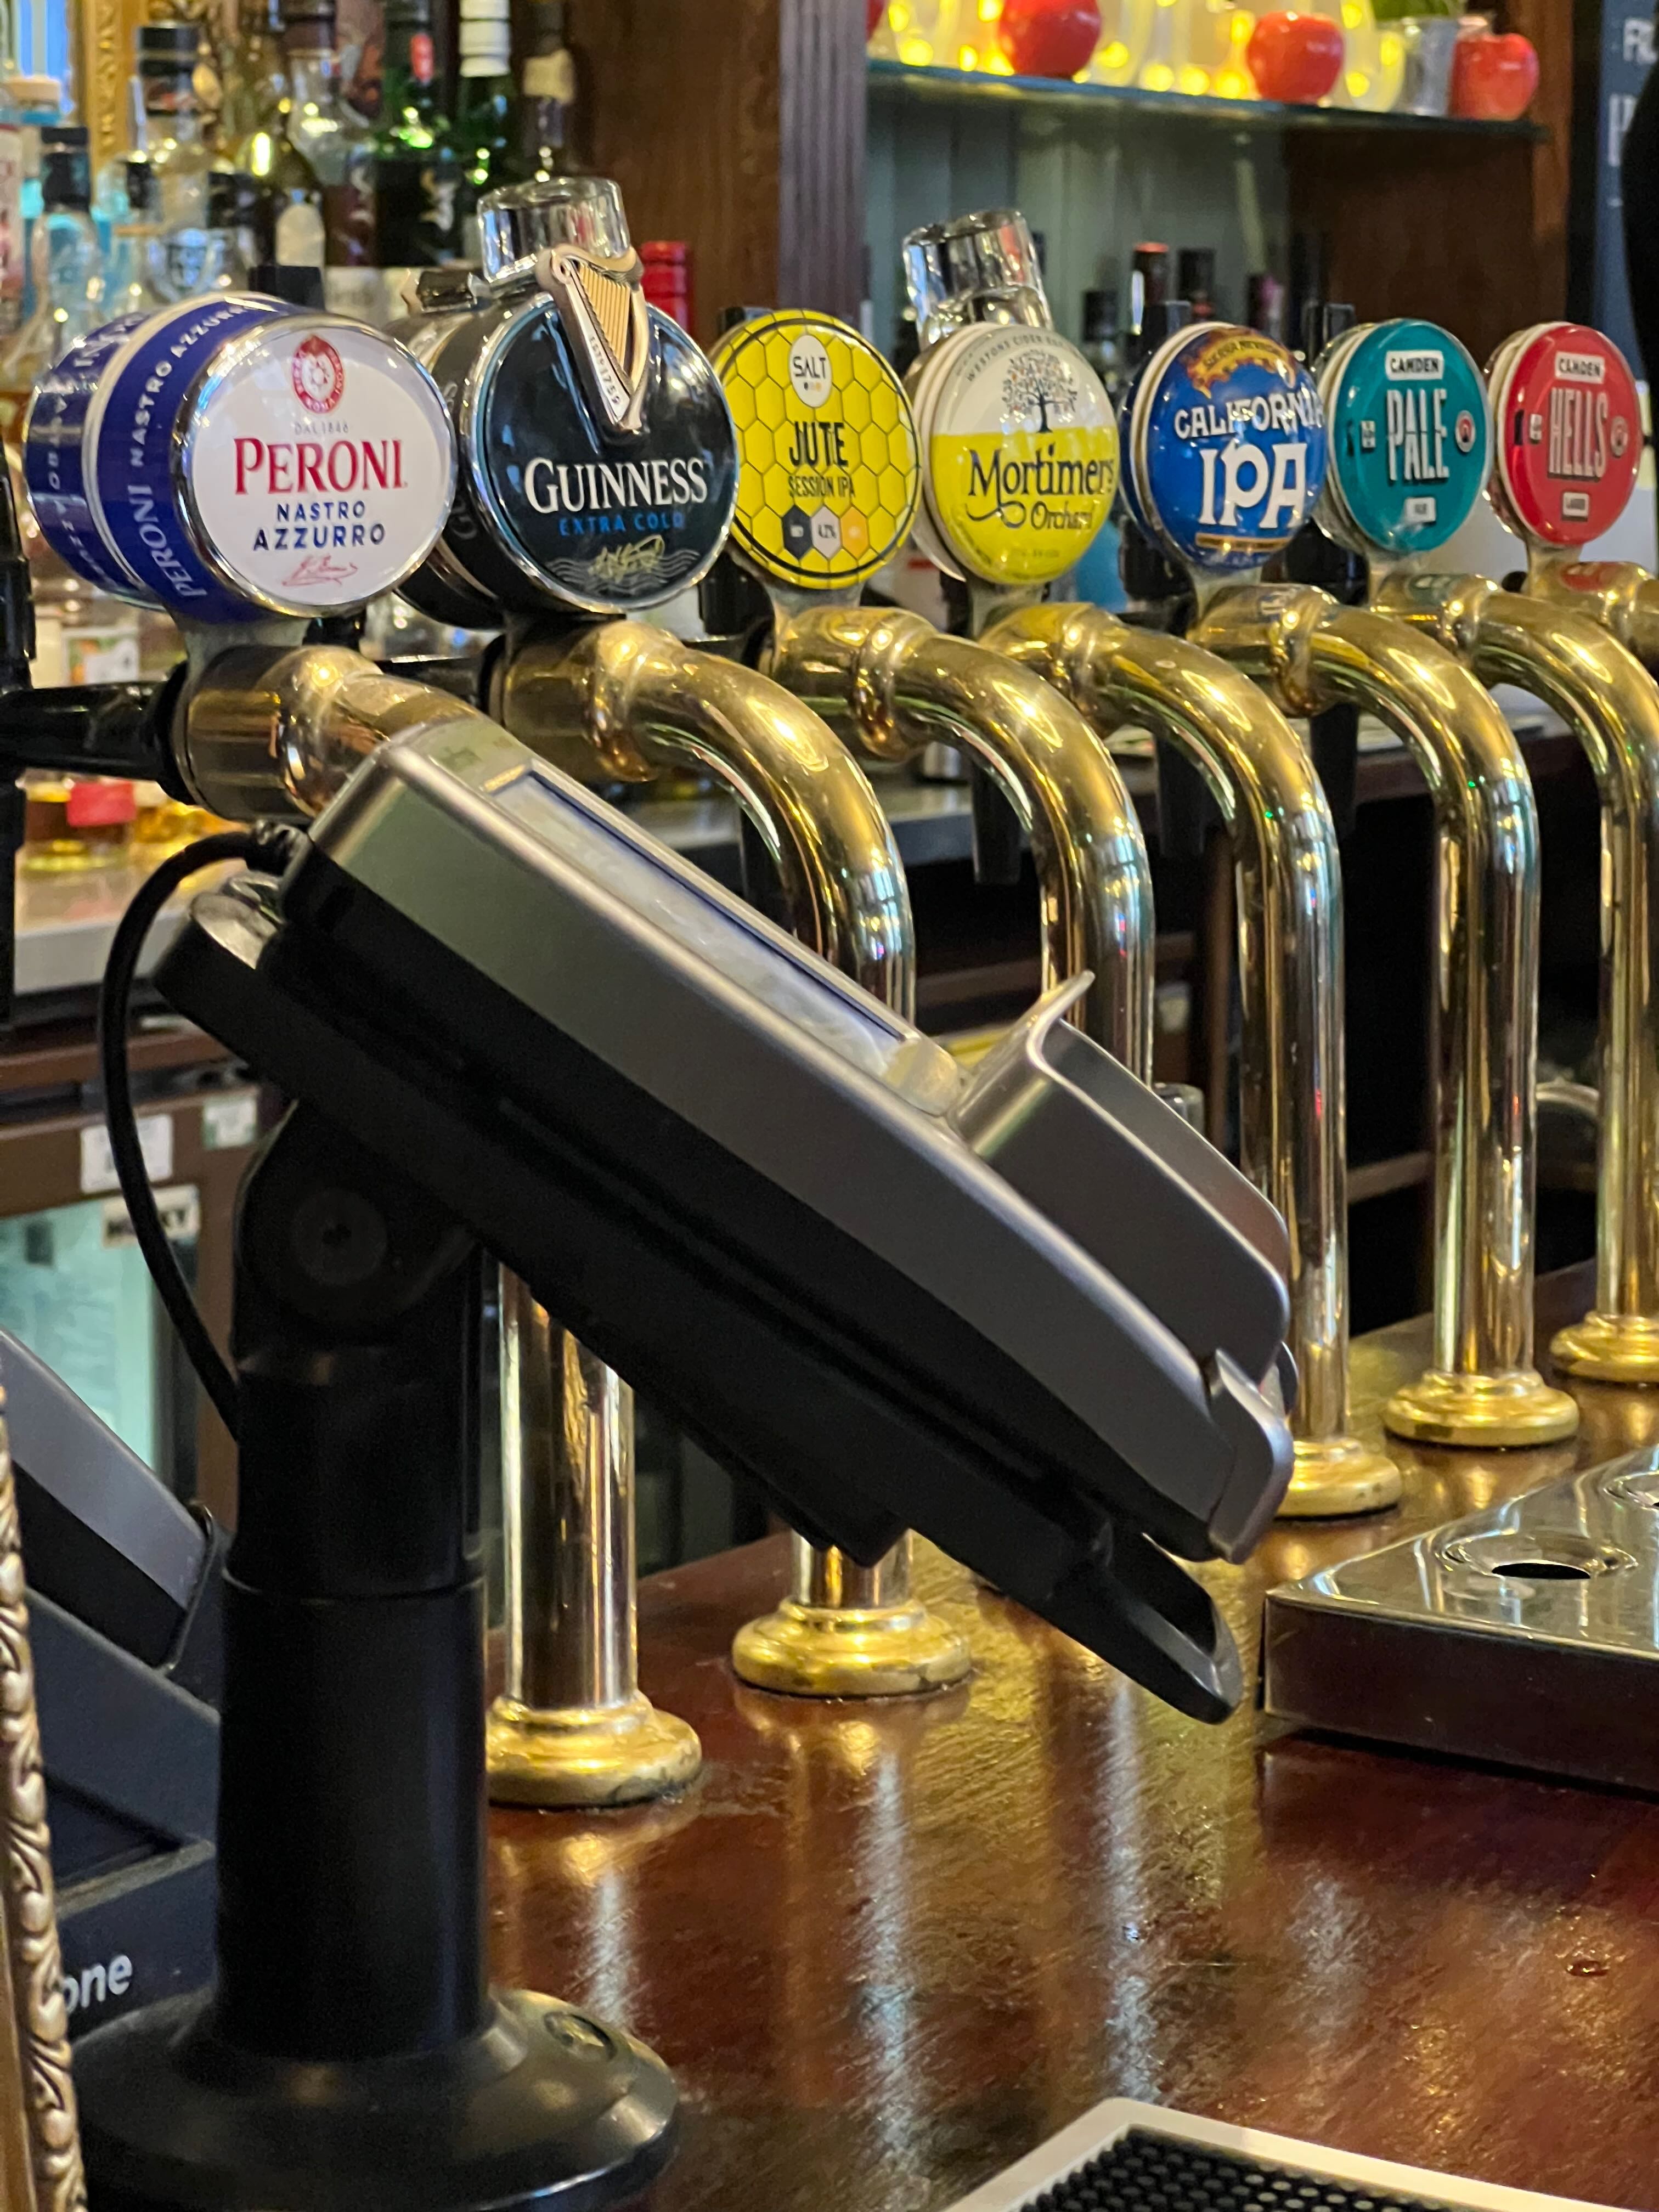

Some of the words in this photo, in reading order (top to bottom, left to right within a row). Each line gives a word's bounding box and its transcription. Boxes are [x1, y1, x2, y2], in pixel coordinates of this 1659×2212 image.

[793, 356, 827, 379] SALT
[1390, 357, 1439, 373] CAMDEN
[1559, 358, 1601, 377] CAMDEN
[600, 369, 620, 405] 1759
[129, 360, 173, 467] NASTRO
[1549, 387, 1608, 478] HELLS
[789, 421, 849, 466] JUTE
[1386, 388, 1449, 481] PALE
[233, 437, 404, 495] PERONI
[524, 457, 708, 514] GUINNESS
[1198, 439, 1307, 528] IPA
[788, 475, 834, 498] SESSION
[837, 476, 856, 498] IPA
[277, 500, 365, 522] NASTRO
[558, 514, 627, 537] EXTRA
[634, 510, 685, 532] COLD
[128, 485, 208, 597] PERONI
[253, 523, 386, 551] AZZURRO
